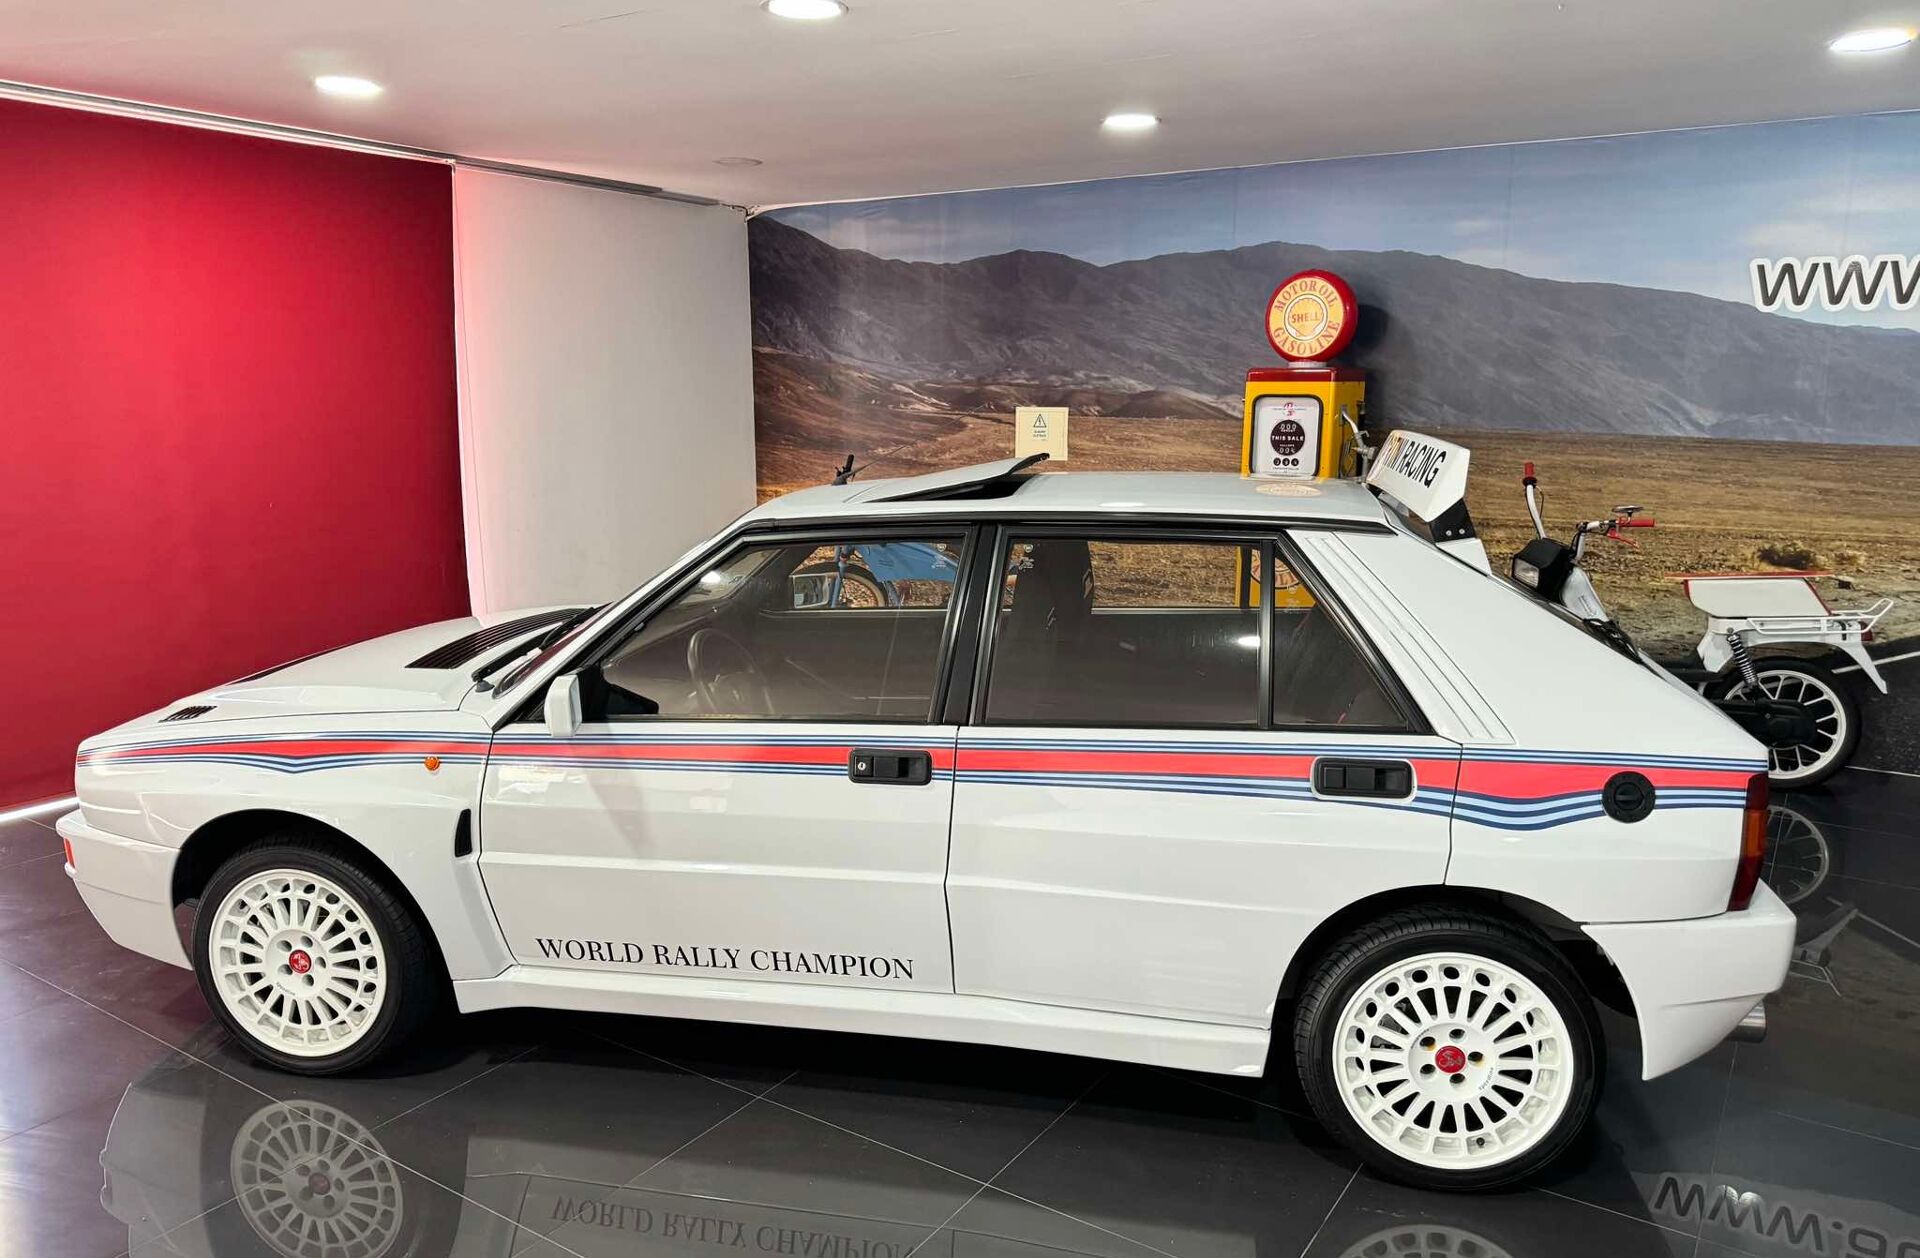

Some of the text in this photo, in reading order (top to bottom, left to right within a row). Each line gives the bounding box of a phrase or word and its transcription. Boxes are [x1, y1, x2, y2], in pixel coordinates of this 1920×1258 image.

[1274, 280, 1338, 312] MOTOR OIL
[1291, 311, 1320, 324] SHELL
[1273, 320, 1340, 355] GASOLINE
[1396, 440, 1447, 488] RACING
[536, 938, 914, 980] WORLD RALLY CHAMPION
